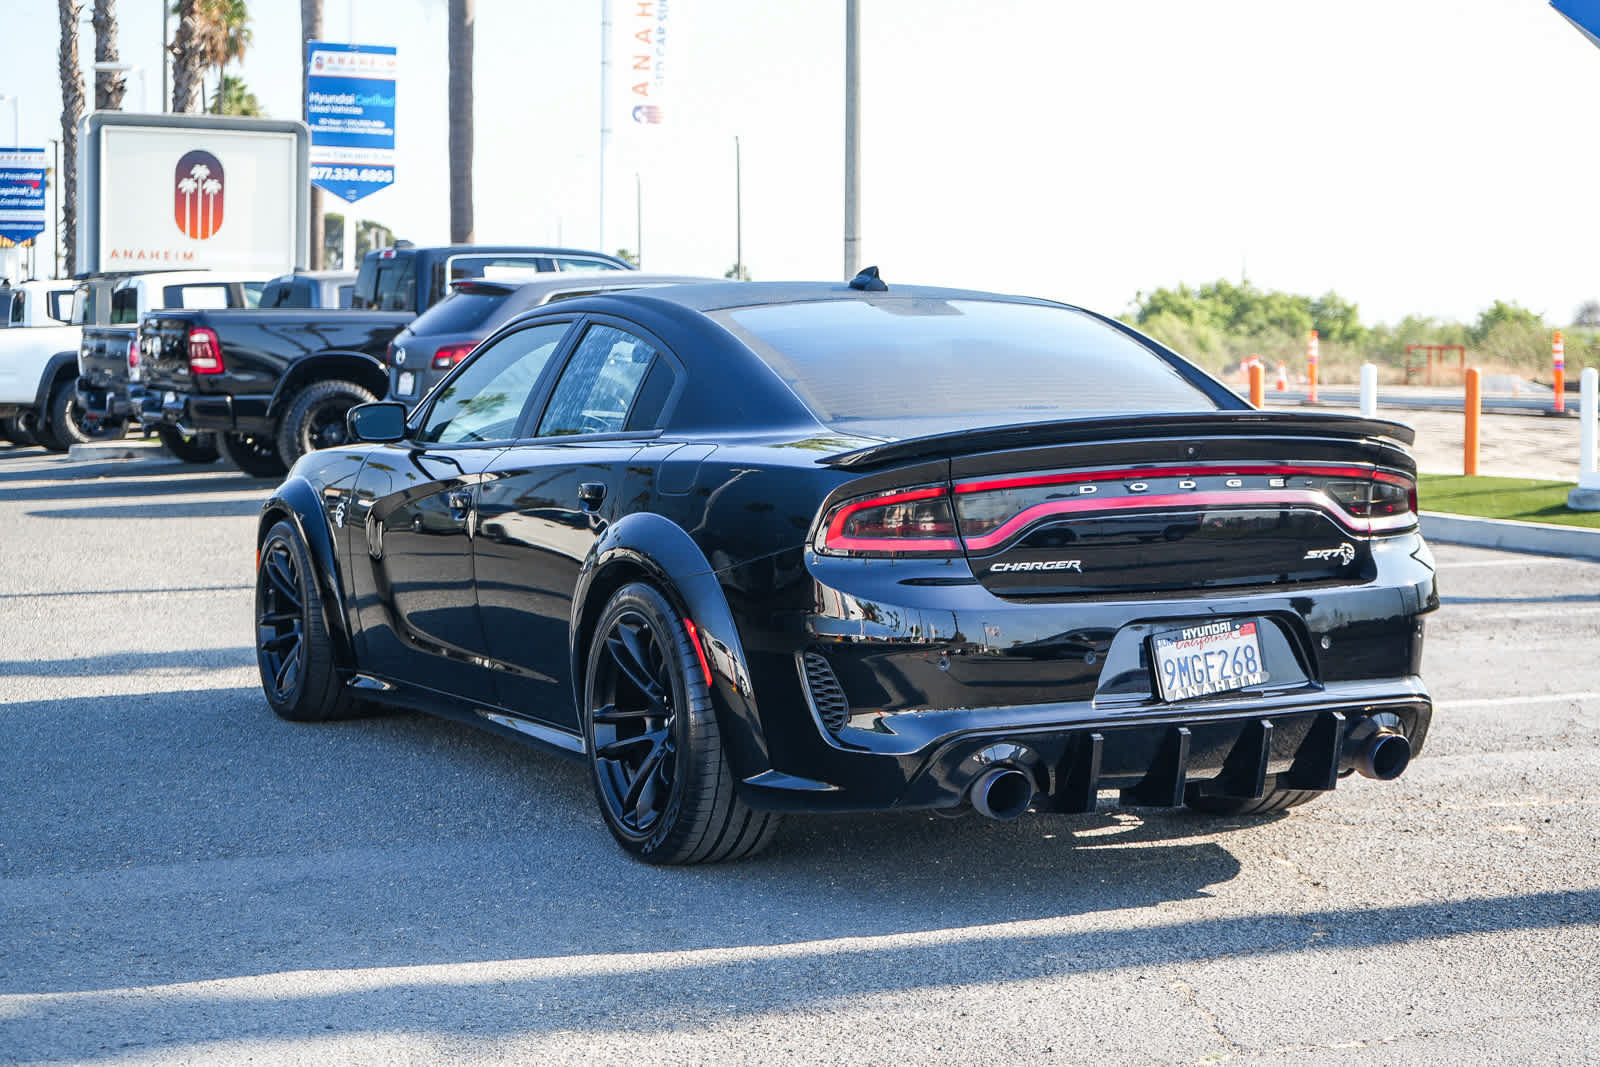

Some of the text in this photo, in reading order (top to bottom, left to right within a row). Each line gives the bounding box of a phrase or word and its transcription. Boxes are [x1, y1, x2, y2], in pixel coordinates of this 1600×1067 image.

[110, 248, 195, 260] ANAHEIM
[1079, 478, 1286, 494] DODGE
[1304, 548, 1345, 561] SRT
[990, 559, 1082, 573] CHARGER
[1182, 621, 1232, 640] HYUNDAI
[1163, 644, 1258, 690] 9MGF268
[1174, 672, 1261, 700] ANAHEIM
